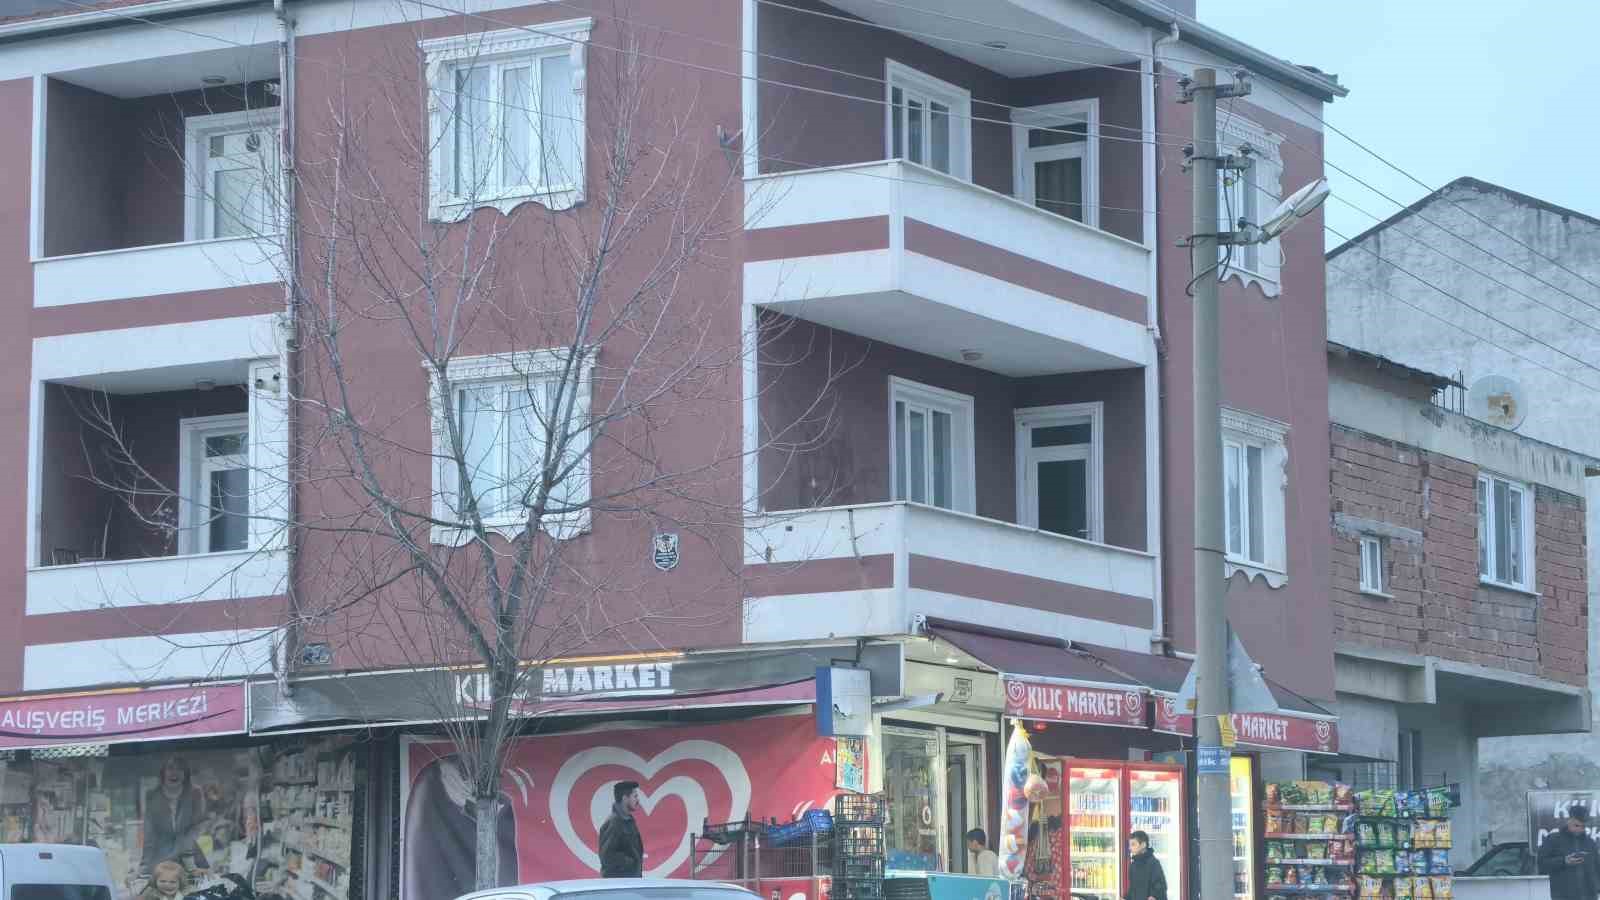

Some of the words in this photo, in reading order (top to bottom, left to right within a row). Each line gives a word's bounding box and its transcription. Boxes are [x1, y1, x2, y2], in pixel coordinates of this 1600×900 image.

[542, 662, 673, 694] MARKET
[1, 705, 105, 734] ALIŞVERİŞ
[117, 690, 208, 726] MERKEZİ
[1027, 686, 1063, 719] KILIÇ
[1067, 690, 1123, 717] MARKET
[1241, 714, 1289, 742] MARKET
